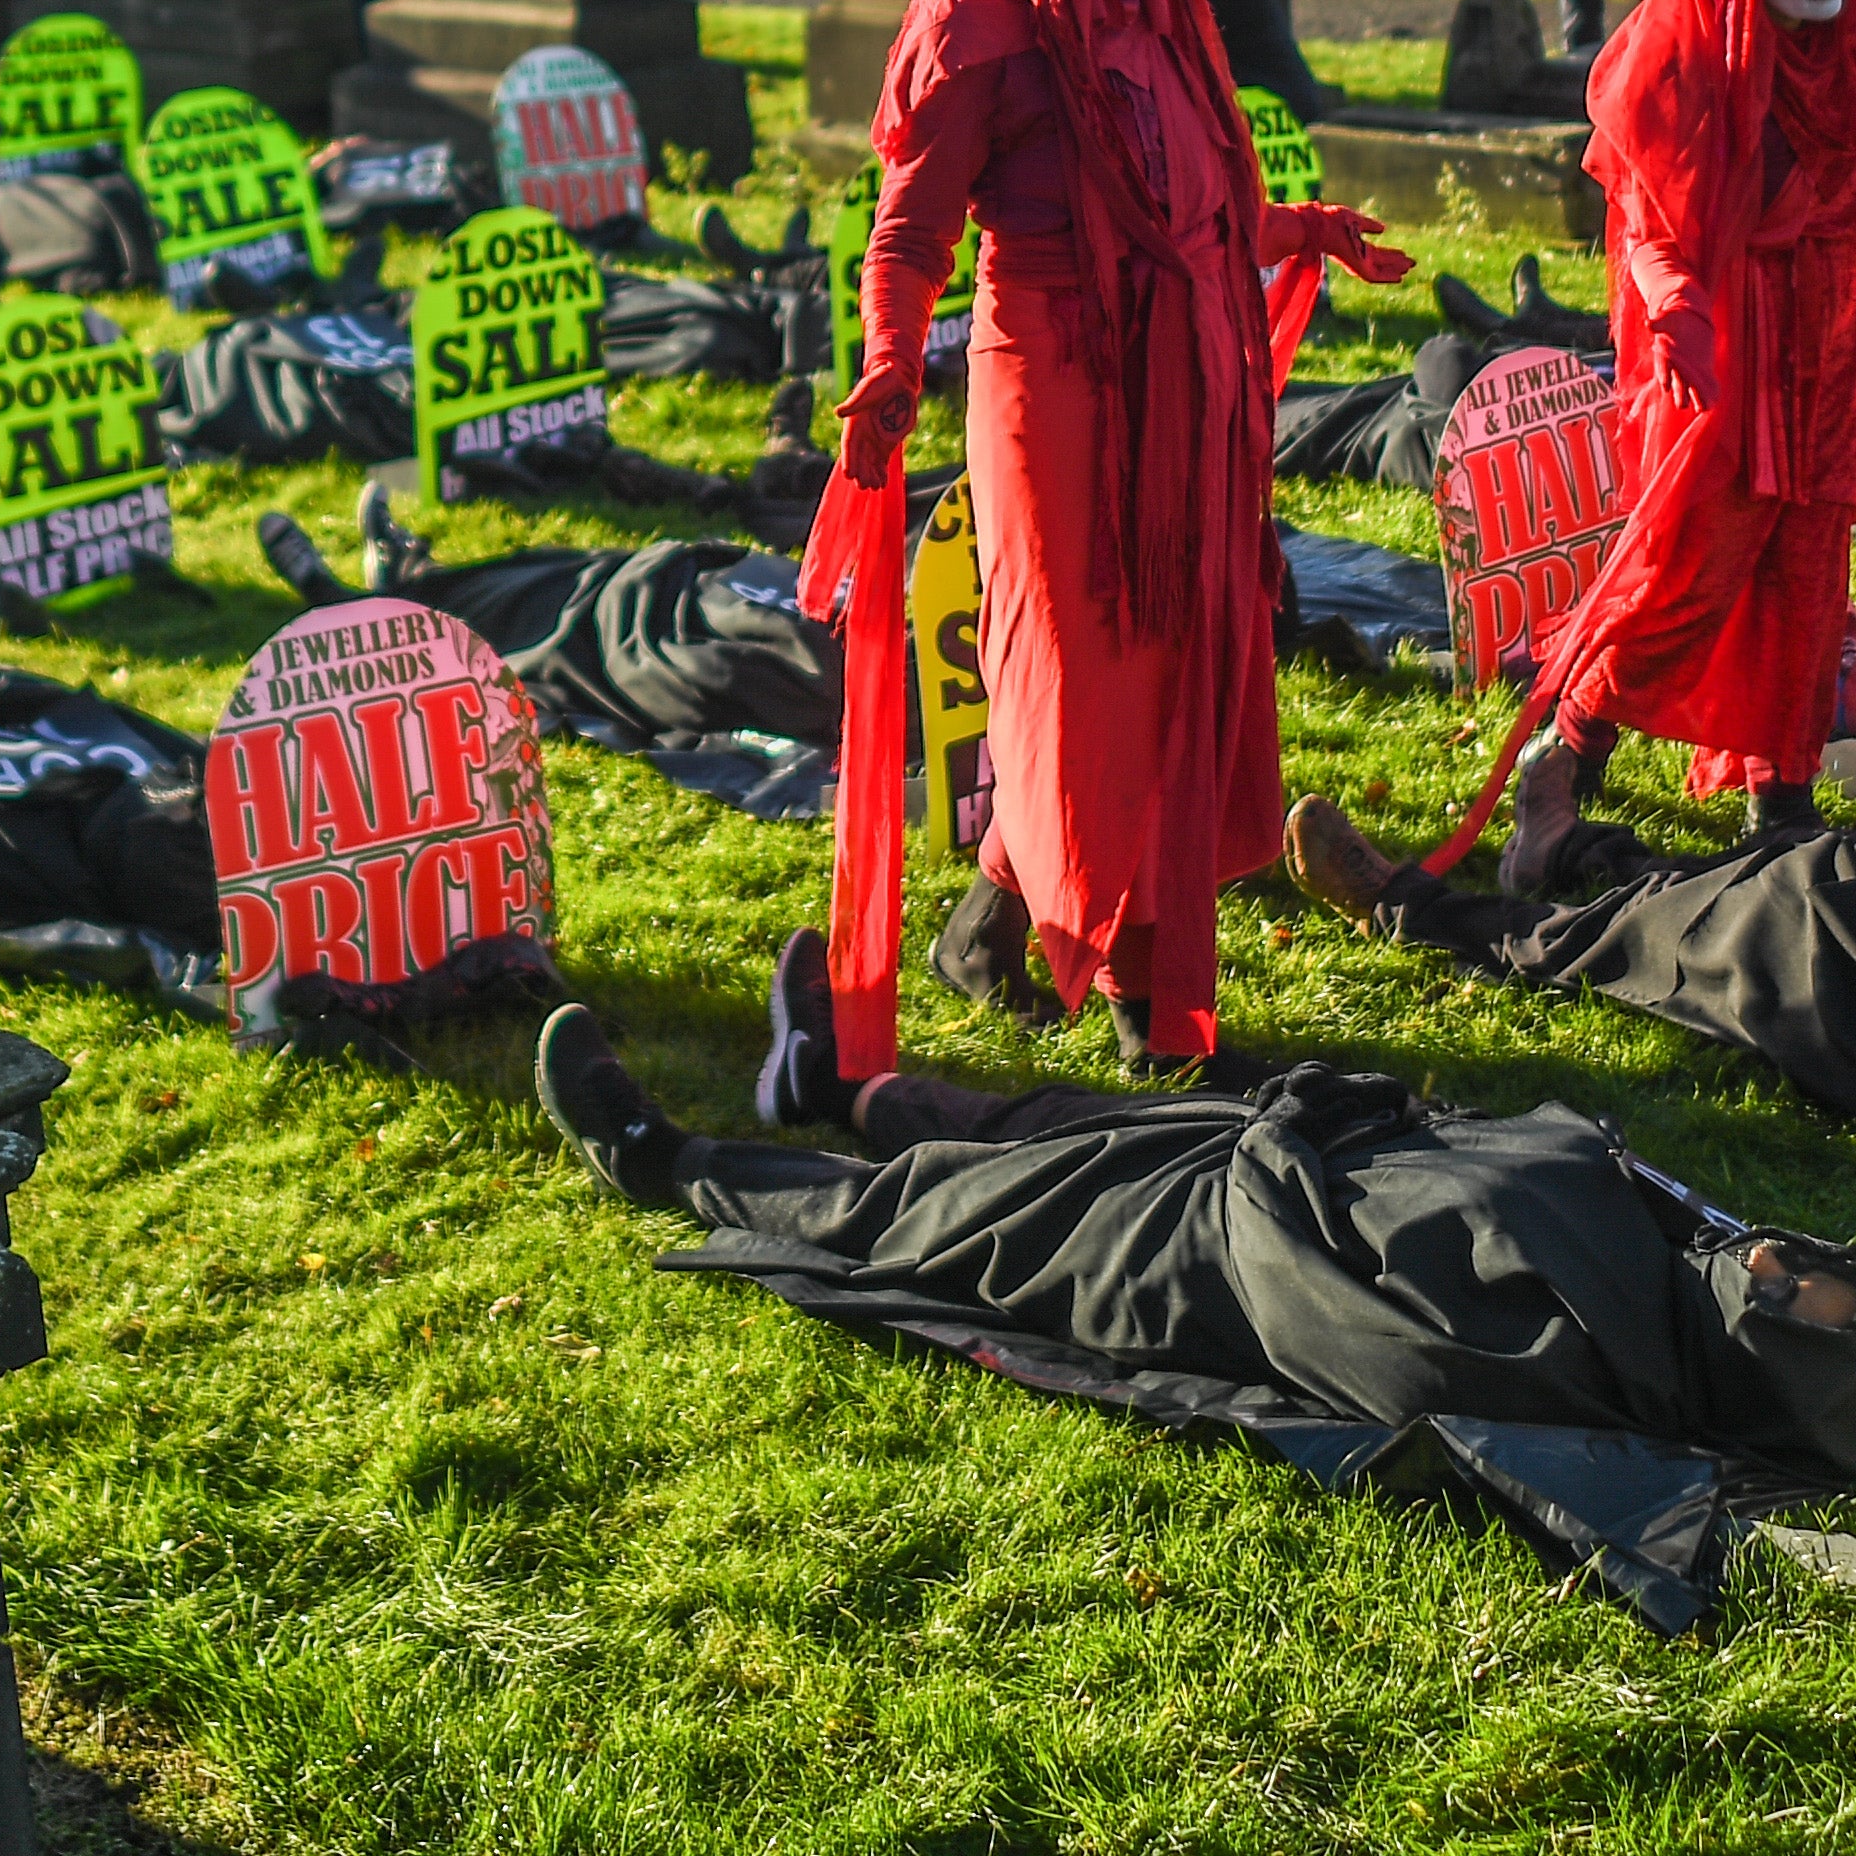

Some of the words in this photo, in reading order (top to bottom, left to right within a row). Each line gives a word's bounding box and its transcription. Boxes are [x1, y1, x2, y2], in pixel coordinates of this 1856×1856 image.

[150, 138, 264, 179] DOWN
[457, 263, 591, 320] DOWN
[455, 416, 501, 455] All
[507, 384, 607, 443] Stock
[1467, 379, 1502, 412] ALL
[1484, 409, 1501, 436] &
[1506, 378, 1609, 430] DIAMONDS
[46, 483, 172, 550] Stock
[270, 609, 448, 676] JEWELLERY
[1463, 531, 1626, 690] PRI
[229, 684, 256, 719] &
[268, 646, 436, 712] DIAMONDS
[206, 678, 491, 882] HALF
